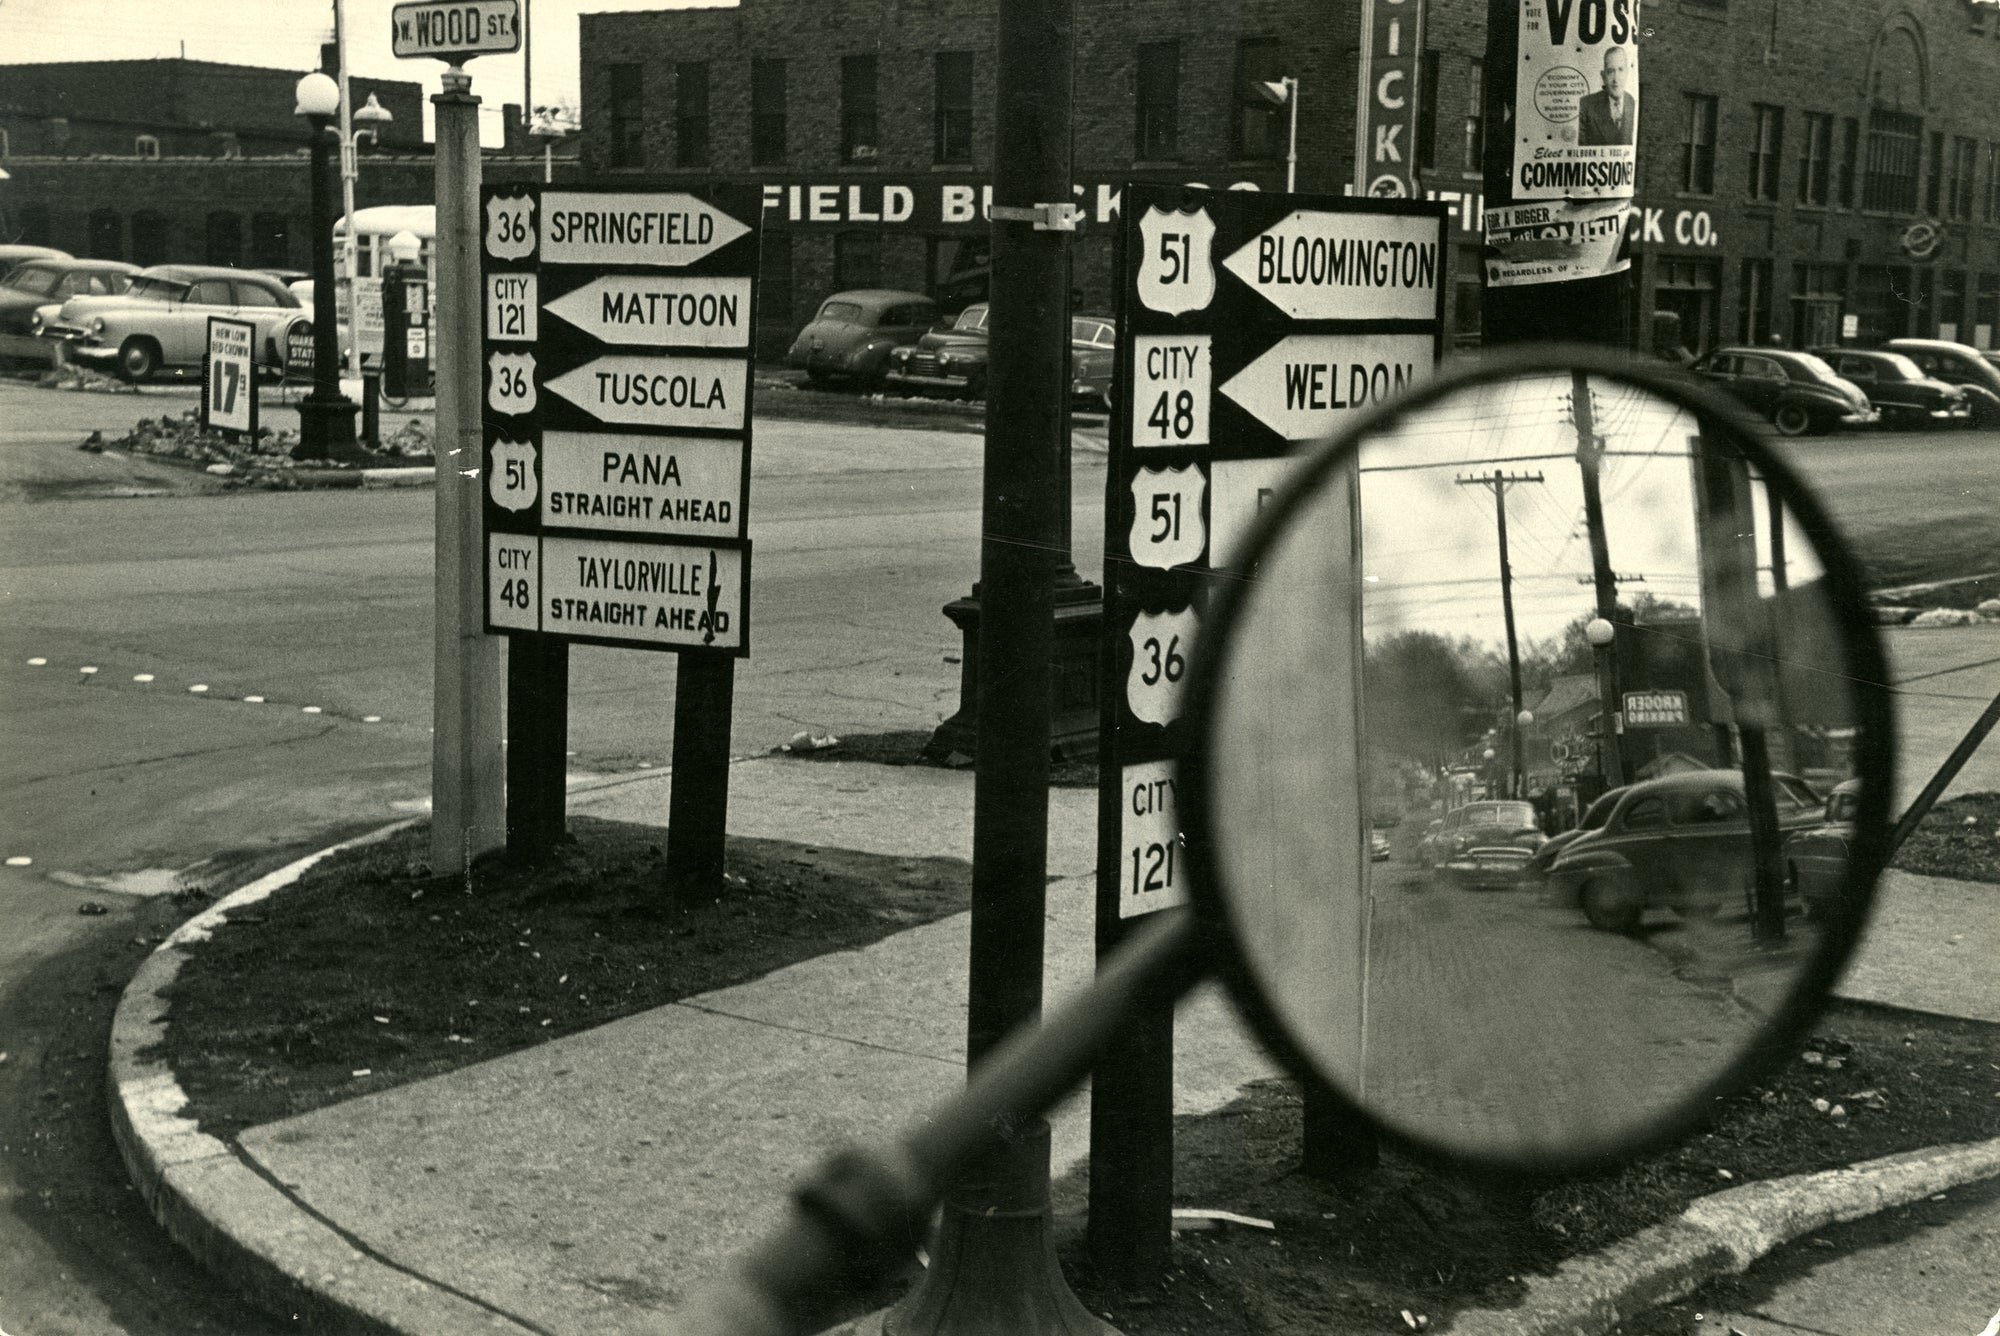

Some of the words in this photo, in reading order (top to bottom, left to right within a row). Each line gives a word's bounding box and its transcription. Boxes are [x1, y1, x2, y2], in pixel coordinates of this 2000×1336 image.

[400, 20, 413, 42] W.
[415, 7, 480, 47] WOOD
[487, 14, 509, 36] ST.
[1526, 8, 1541, 18] VOTE
[1527, 21, 1540, 31] FOR
[1375, 0, 1405, 162] ICK
[1534, 147, 1563, 160] Elect
[763, 185, 914, 221] FIELD
[1487, 213, 1501, 229] FOR
[1503, 212, 1510, 227] A
[1514, 207, 1550, 225] BIGGER
[497, 210, 527, 244] 36
[551, 211, 714, 245] SPRINGFIELD
[1675, 210, 1718, 246] CO.
[1159, 233, 1191, 285] 51
[1258, 235, 1437, 290] BLOOMINGTON
[1502, 266, 1553, 278] REGARDLESS
[1558, 264, 1568, 273] OF
[495, 278, 529, 300] CITY
[497, 303, 526, 336] 121
[602, 291, 738, 327] MATTOON
[289, 334, 315, 347] QUAKE
[291, 346, 315, 360] STAT
[1147, 346, 1199, 380] CITY
[213, 359, 240, 415] 17
[499, 366, 527, 399] 36
[595, 372, 726, 410] TUSCOLA
[1285, 362, 1413, 410] WELDON
[1147, 389, 1194, 439] 48
[506, 459, 526, 491] 51
[603, 452, 682, 487] PANA
[550, 491, 653, 519] STRAIGHT
[659, 498, 731, 524] AHEAD
[1150, 491, 1182, 544] 51
[498, 547, 532, 571] CITY
[577, 556, 703, 597] TAYLORVILLE
[500, 578, 530, 610] 48
[551, 597, 648, 627] STRAIGHT
[654, 606, 730, 634] AHEAD
[1141, 633, 1186, 687] 36
[1132, 839, 1176, 896] 121
